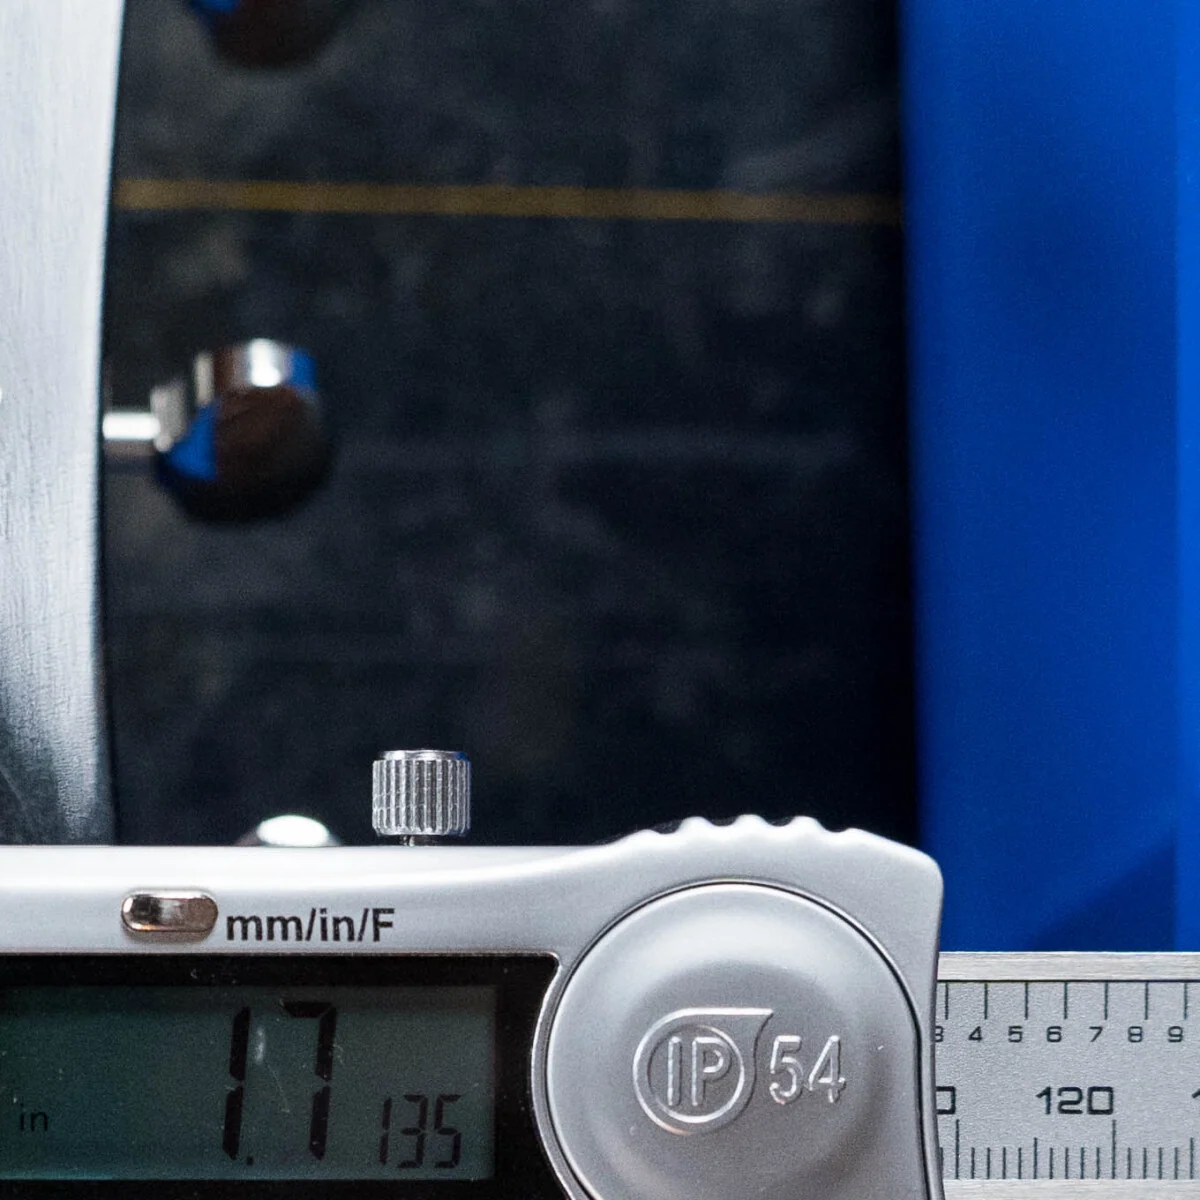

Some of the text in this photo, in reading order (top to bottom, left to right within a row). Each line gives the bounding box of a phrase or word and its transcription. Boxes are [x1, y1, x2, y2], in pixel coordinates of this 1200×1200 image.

[226, 907, 395, 942] mm/in/F
[968, 1026, 983, 1042] 4
[1008, 1026, 1023, 1043] 5
[1046, 1026, 1062, 1043] 6
[1089, 1026, 1103, 1042] 7
[1127, 1026, 1143, 1043] 8
[1168, 1026, 1184, 1043] 9
[666, 1034, 847, 1106] IP 54
[1035, 1086, 1114, 1115] 120
[20, 1104, 50, 1132] in
